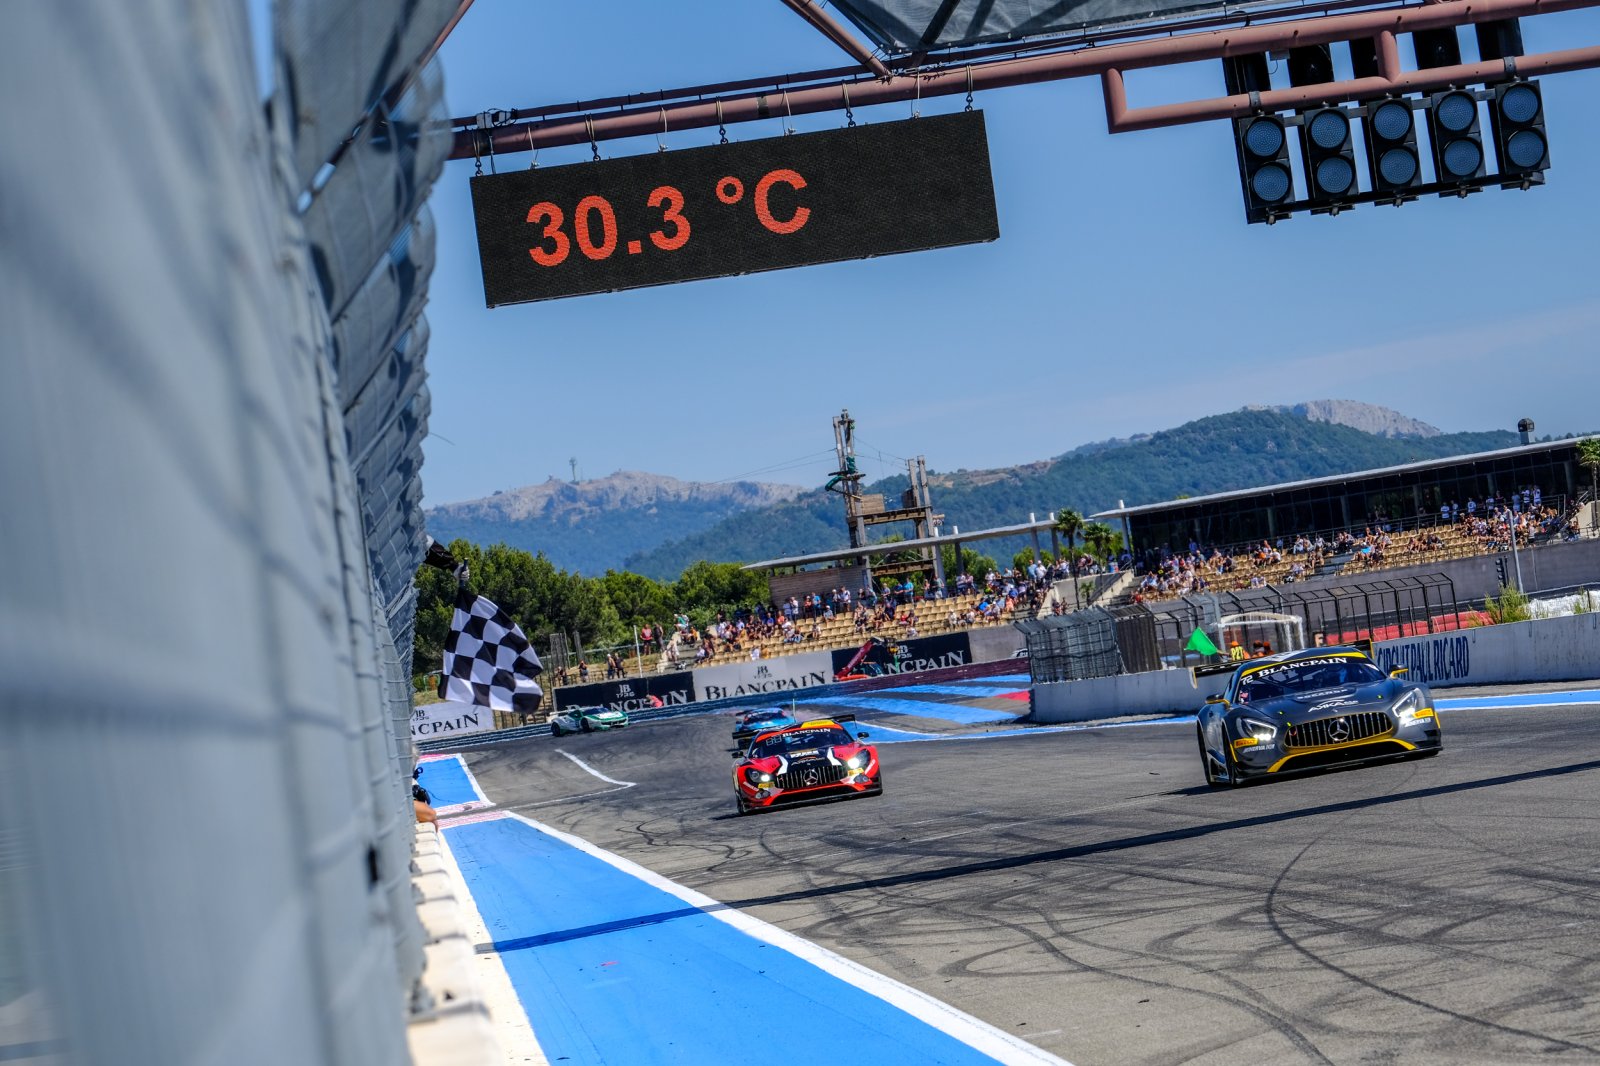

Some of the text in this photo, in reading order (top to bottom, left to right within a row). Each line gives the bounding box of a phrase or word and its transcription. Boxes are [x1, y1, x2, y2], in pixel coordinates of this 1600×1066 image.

[526, 168, 811, 267] 30.3 °C
[1257, 657, 1348, 677] BLANCPAIN
[1433, 636, 1470, 681] RICARD
[704, 671, 826, 701] BLANCPAIN
[1240, 674, 1254, 686] 72
[782, 728, 831, 738] BLANCPAIN
